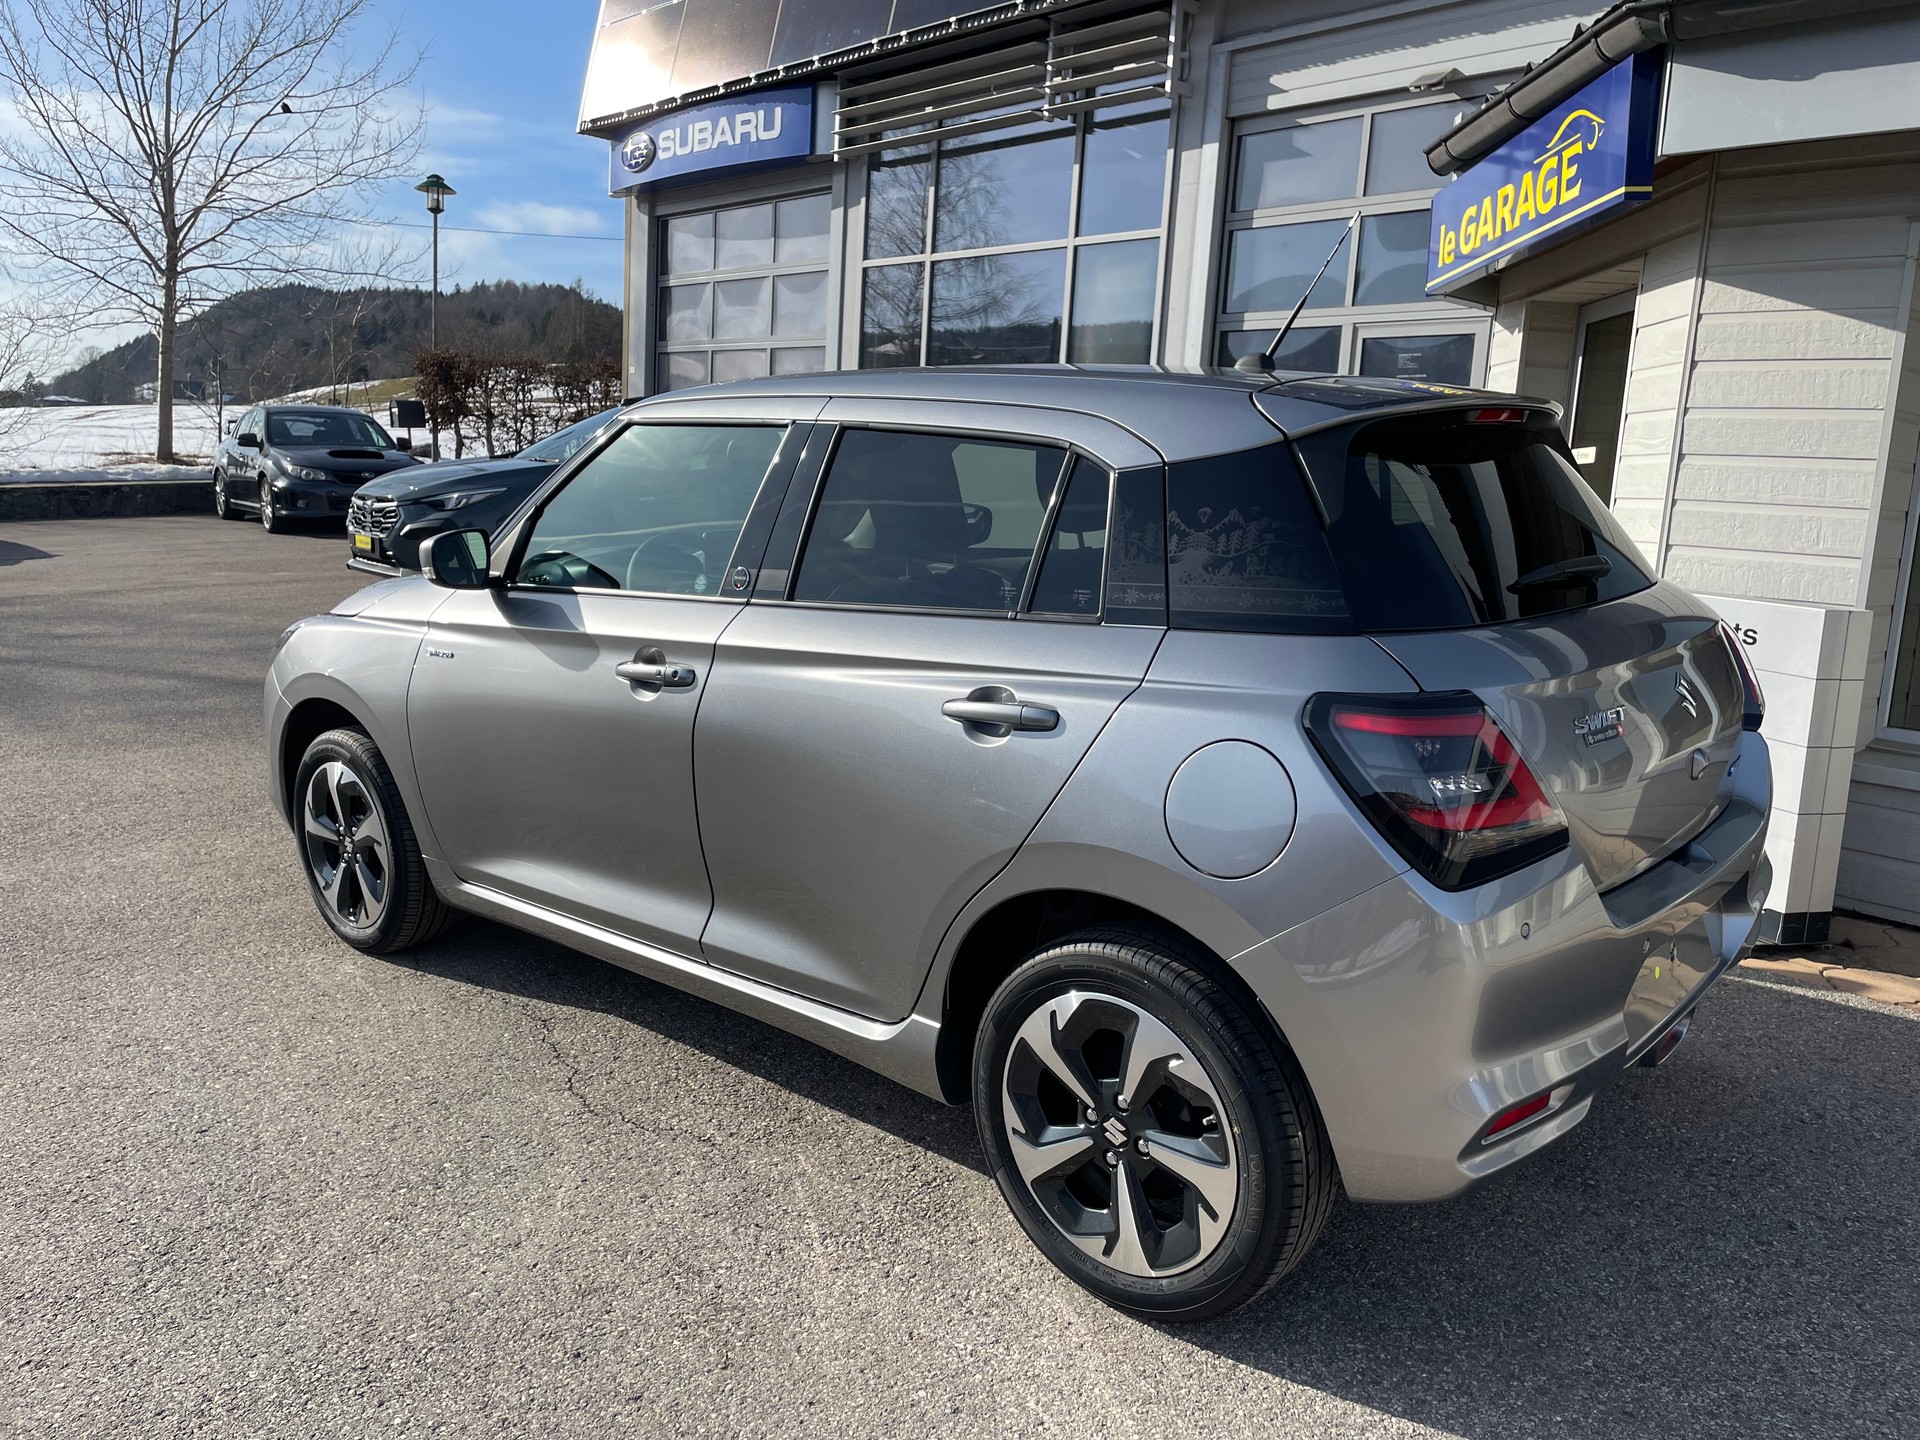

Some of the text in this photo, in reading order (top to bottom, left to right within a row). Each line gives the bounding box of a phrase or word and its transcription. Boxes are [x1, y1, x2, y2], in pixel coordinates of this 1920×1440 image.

[658, 107, 782, 160] SUBARU
[1438, 140, 1583, 268] le GARAGE
[1573, 706, 1625, 734] SWIFT
